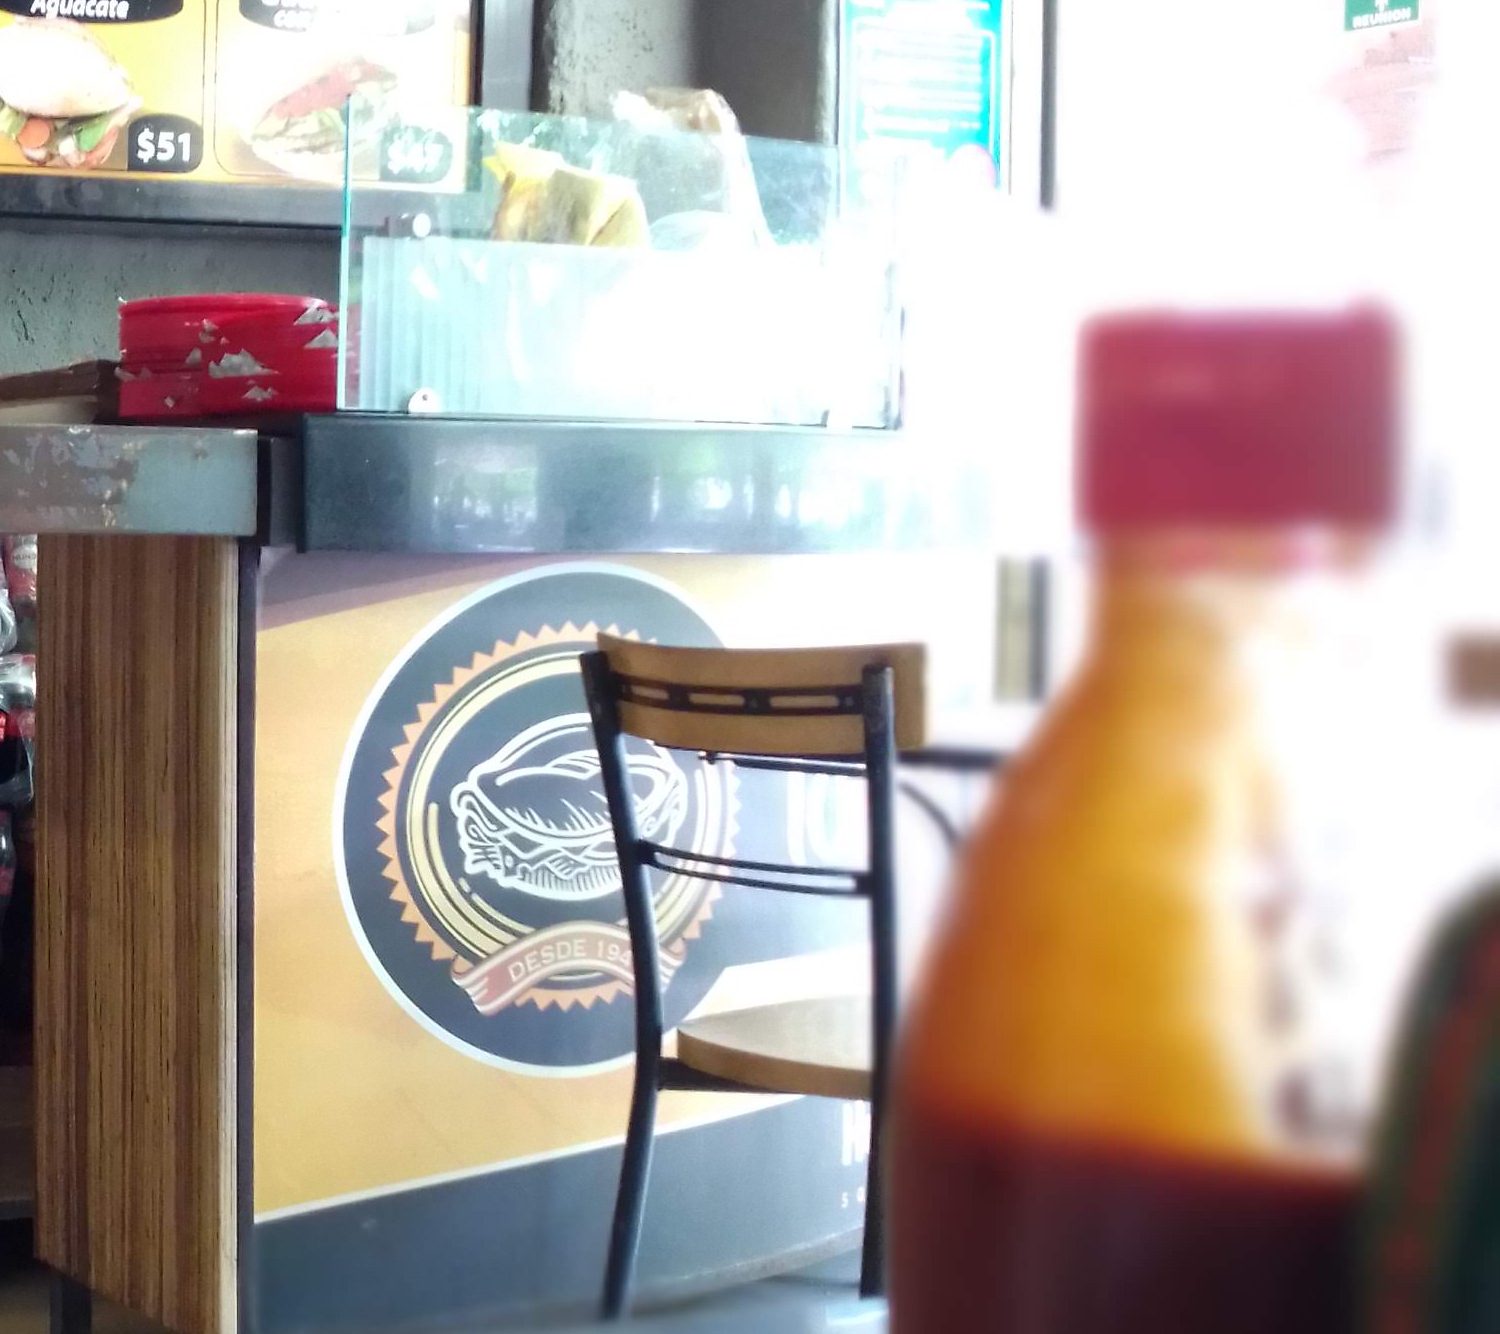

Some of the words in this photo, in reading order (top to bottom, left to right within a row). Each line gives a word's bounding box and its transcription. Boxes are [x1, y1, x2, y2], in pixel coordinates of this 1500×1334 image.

[137, 129, 192, 163] $51
[508, 939, 586, 982] DESDE
[598, 940, 633, 966] 194
